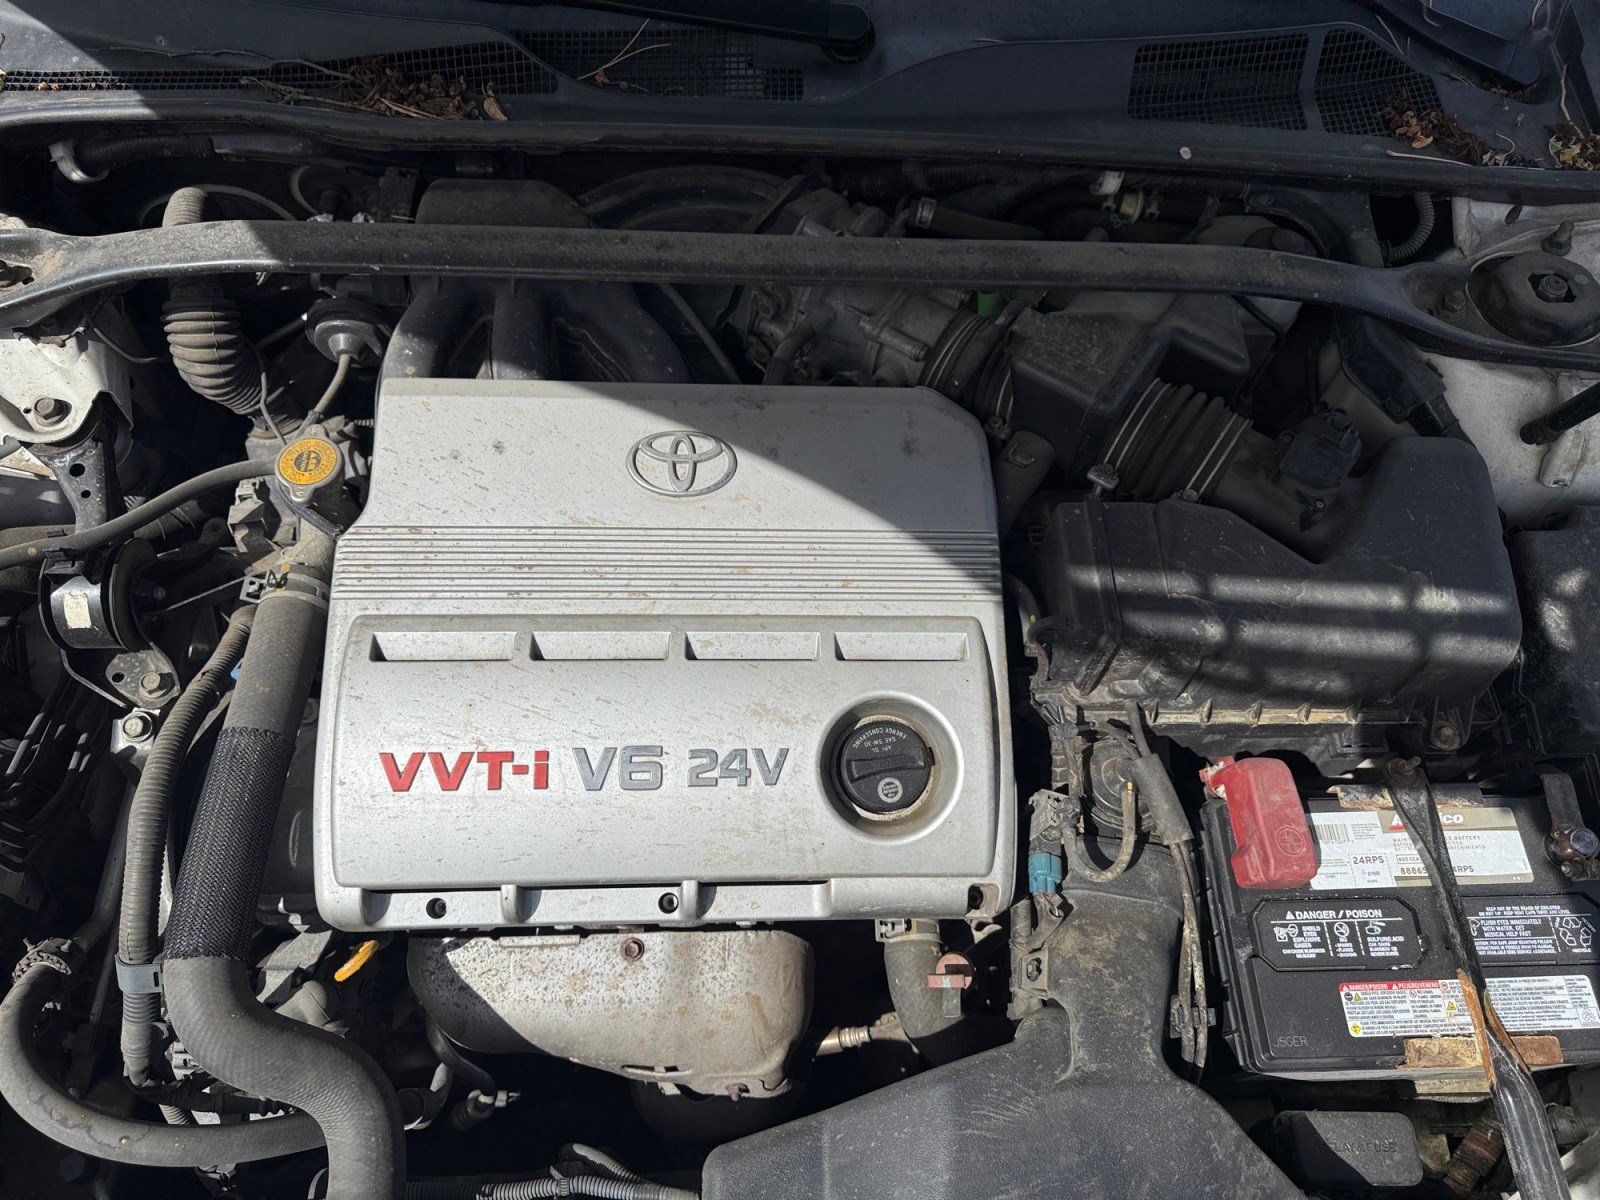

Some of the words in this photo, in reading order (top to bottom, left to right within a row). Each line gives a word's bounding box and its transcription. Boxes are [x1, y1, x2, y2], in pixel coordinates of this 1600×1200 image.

[884, 736, 897, 744] SAE
[379, 750, 549, 791] VVT-i
[572, 745, 664, 791] V6
[687, 748, 790, 788] 24V
[1352, 856, 1384, 865] 24RPS
[1453, 865, 1474, 873] 4RPS
[1295, 910, 1336, 920] DANGER
[1346, 909, 1382, 918] POISON
